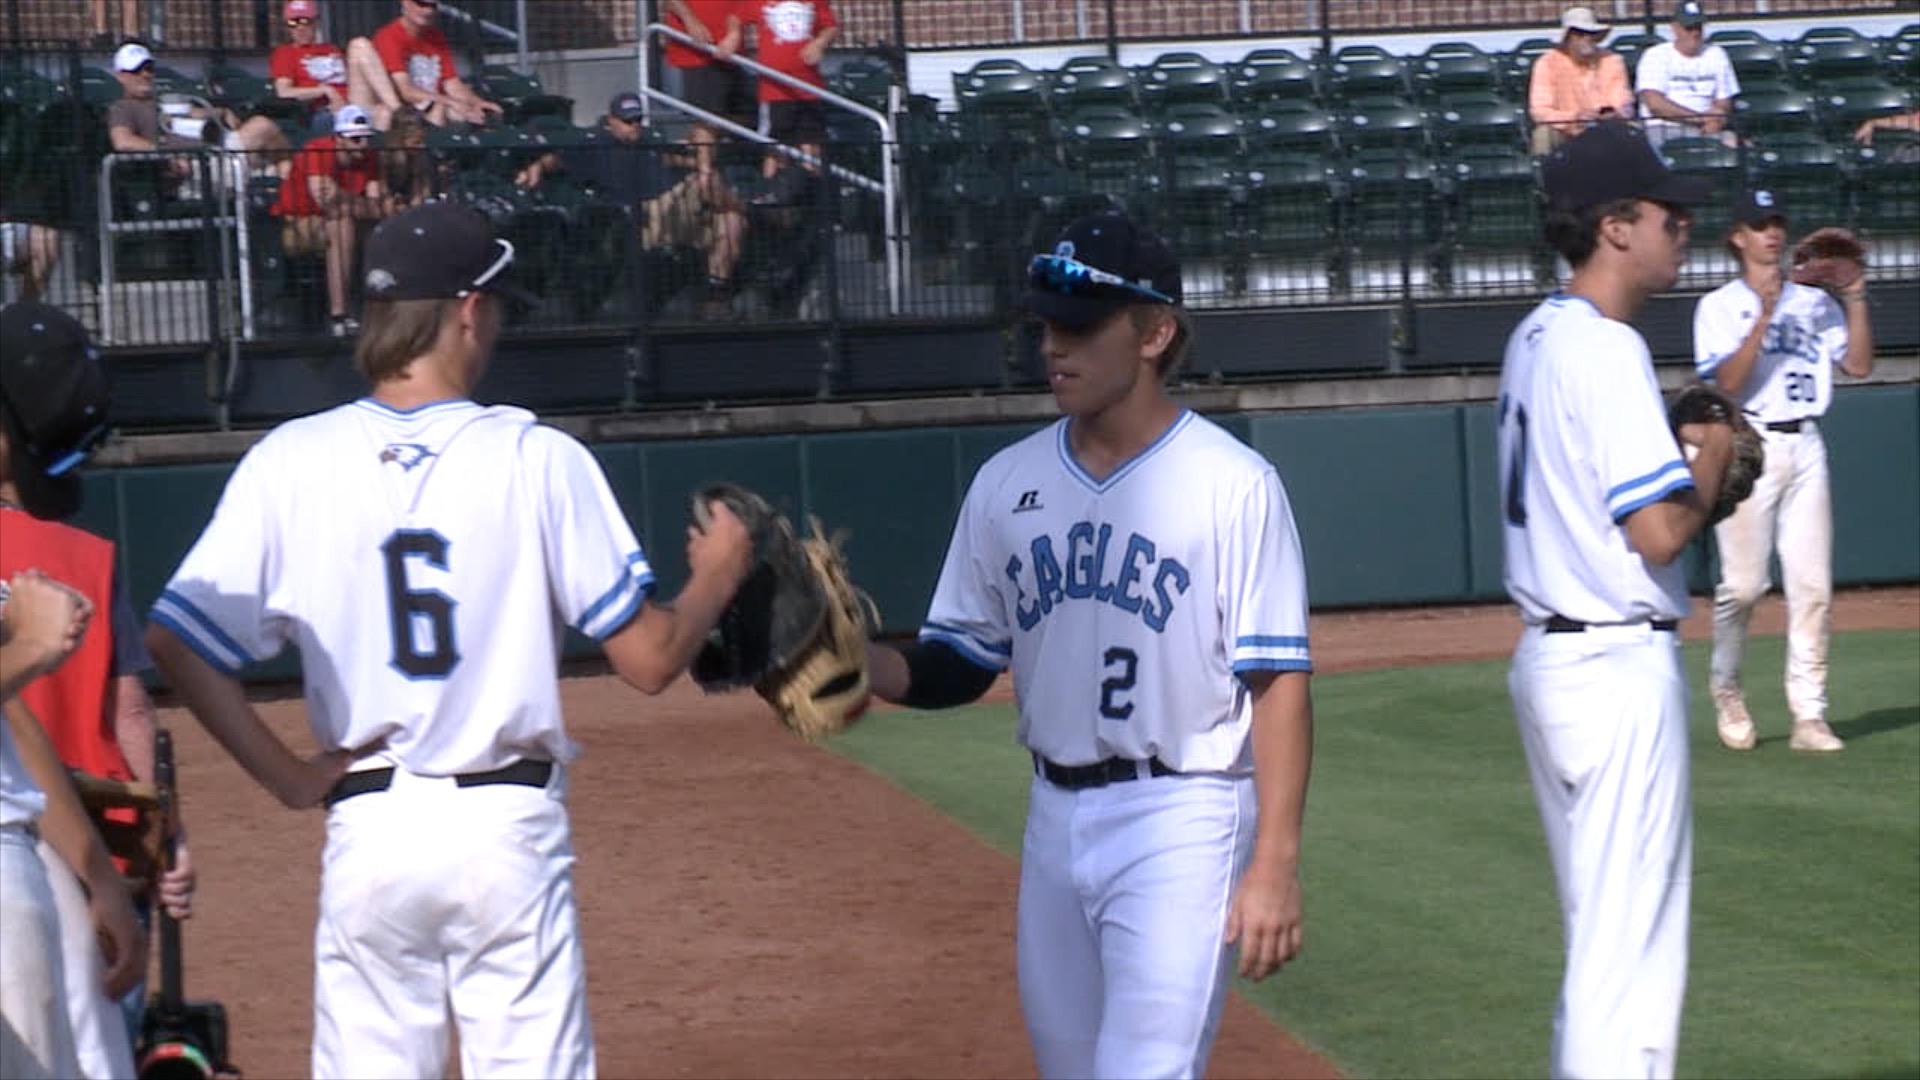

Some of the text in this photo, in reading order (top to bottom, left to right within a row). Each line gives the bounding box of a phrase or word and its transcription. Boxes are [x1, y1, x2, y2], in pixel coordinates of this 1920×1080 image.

[1785, 371, 1817, 403] 20
[379, 528, 462, 681] 6
[1005, 520, 1191, 634] EAGLES
[1099, 646, 1139, 720] 2
